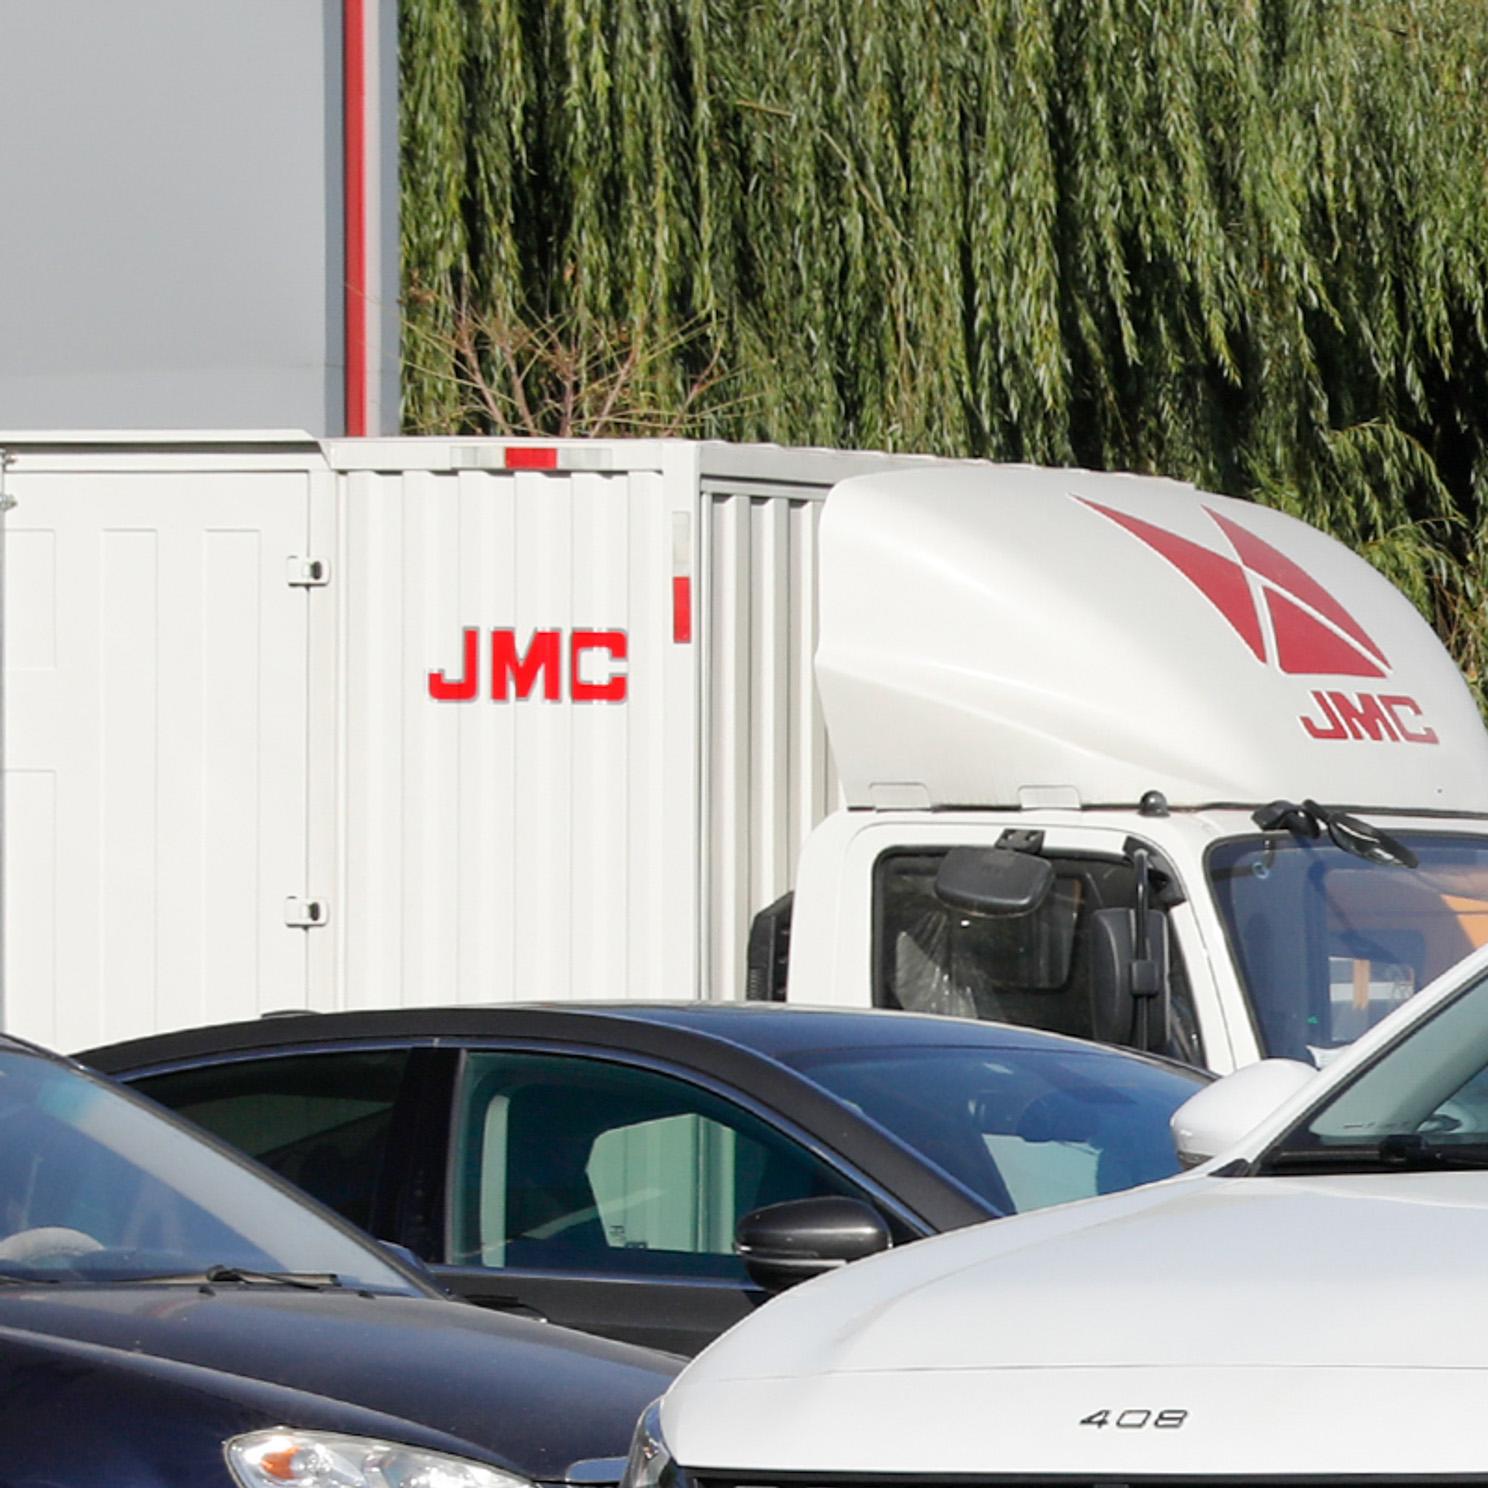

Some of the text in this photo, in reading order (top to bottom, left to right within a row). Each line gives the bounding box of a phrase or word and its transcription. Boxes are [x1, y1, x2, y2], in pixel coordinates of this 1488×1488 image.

[428, 626, 628, 704] JMC
[1297, 689, 1440, 746] JMC
[1079, 1408, 1189, 1429] 408
